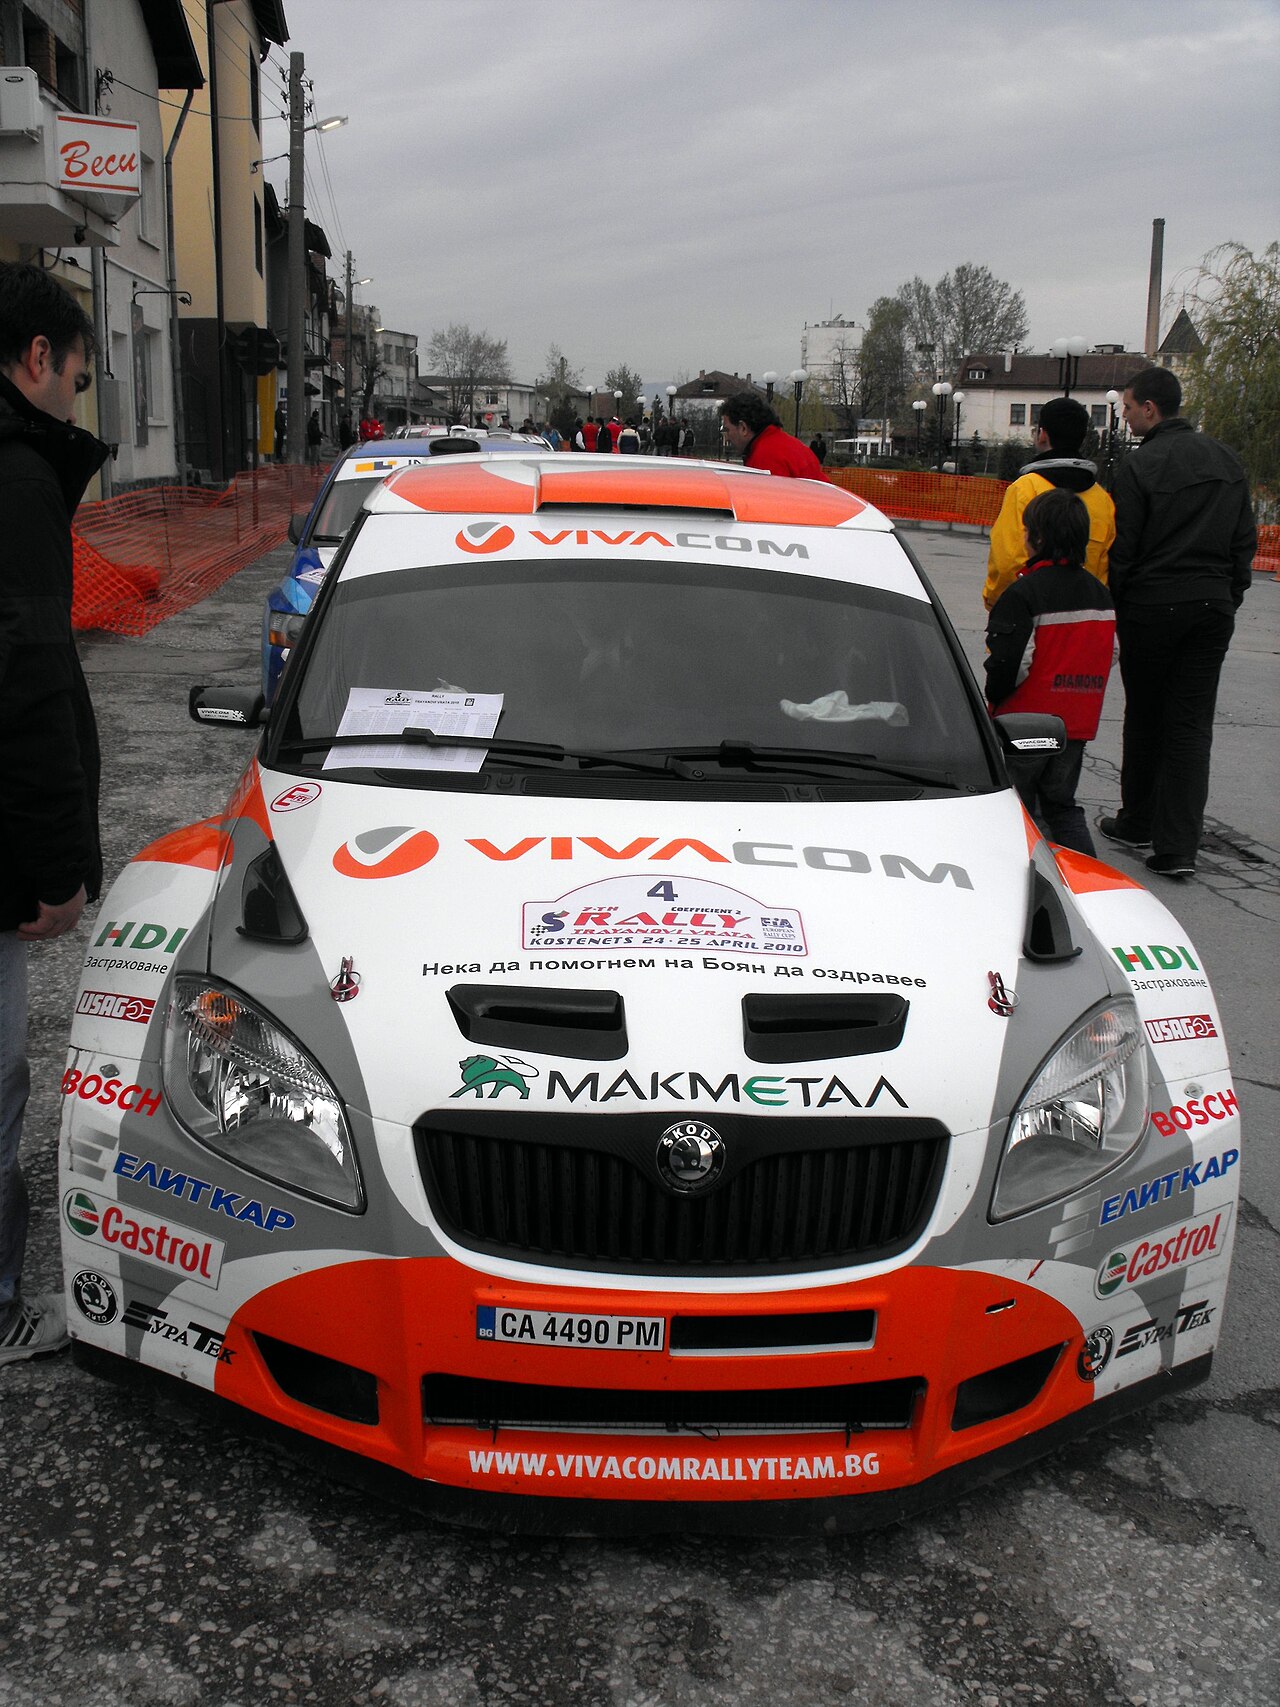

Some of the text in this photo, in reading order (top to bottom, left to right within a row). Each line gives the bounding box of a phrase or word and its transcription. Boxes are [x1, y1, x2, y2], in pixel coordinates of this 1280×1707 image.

[60, 140, 138, 178] Веси
[528, 529, 810, 560] VIVACOM
[464, 836, 975, 892] VIVACOM
[646, 880, 679, 902] 4
[573, 911, 752, 929] RALLY
[671, 906, 733, 914] COEFFICIENT
[94, 921, 189, 954] HDI
[529, 936, 804, 952] KOSTENETS 24 25 APRIL 2010
[689, 928, 757, 939] VRATA
[84, 956, 169, 974] Застраховане
[422, 957, 928, 988] Нека да помогнем на Боян да оздравее
[1111, 945, 1200, 972] HDI
[1130, 977, 1208, 992] Застраховане
[77, 992, 130, 1018] USAG
[1147, 1018, 1196, 1042] USAG
[61, 1068, 163, 1117] BOSCH
[546, 1069, 910, 1109] МАКМЕТАЛ
[1150, 1088, 1240, 1138] BOSCH
[102, 1206, 213, 1280] Castrol
[1126, 1213, 1222, 1284] Castrol
[479, 1327, 493, 1338] BG
[500, 1312, 661, 1347] CA 4490 PM
[468, 1450, 880, 1481] WWW.VIVACOMRALLYTEAM.BG
